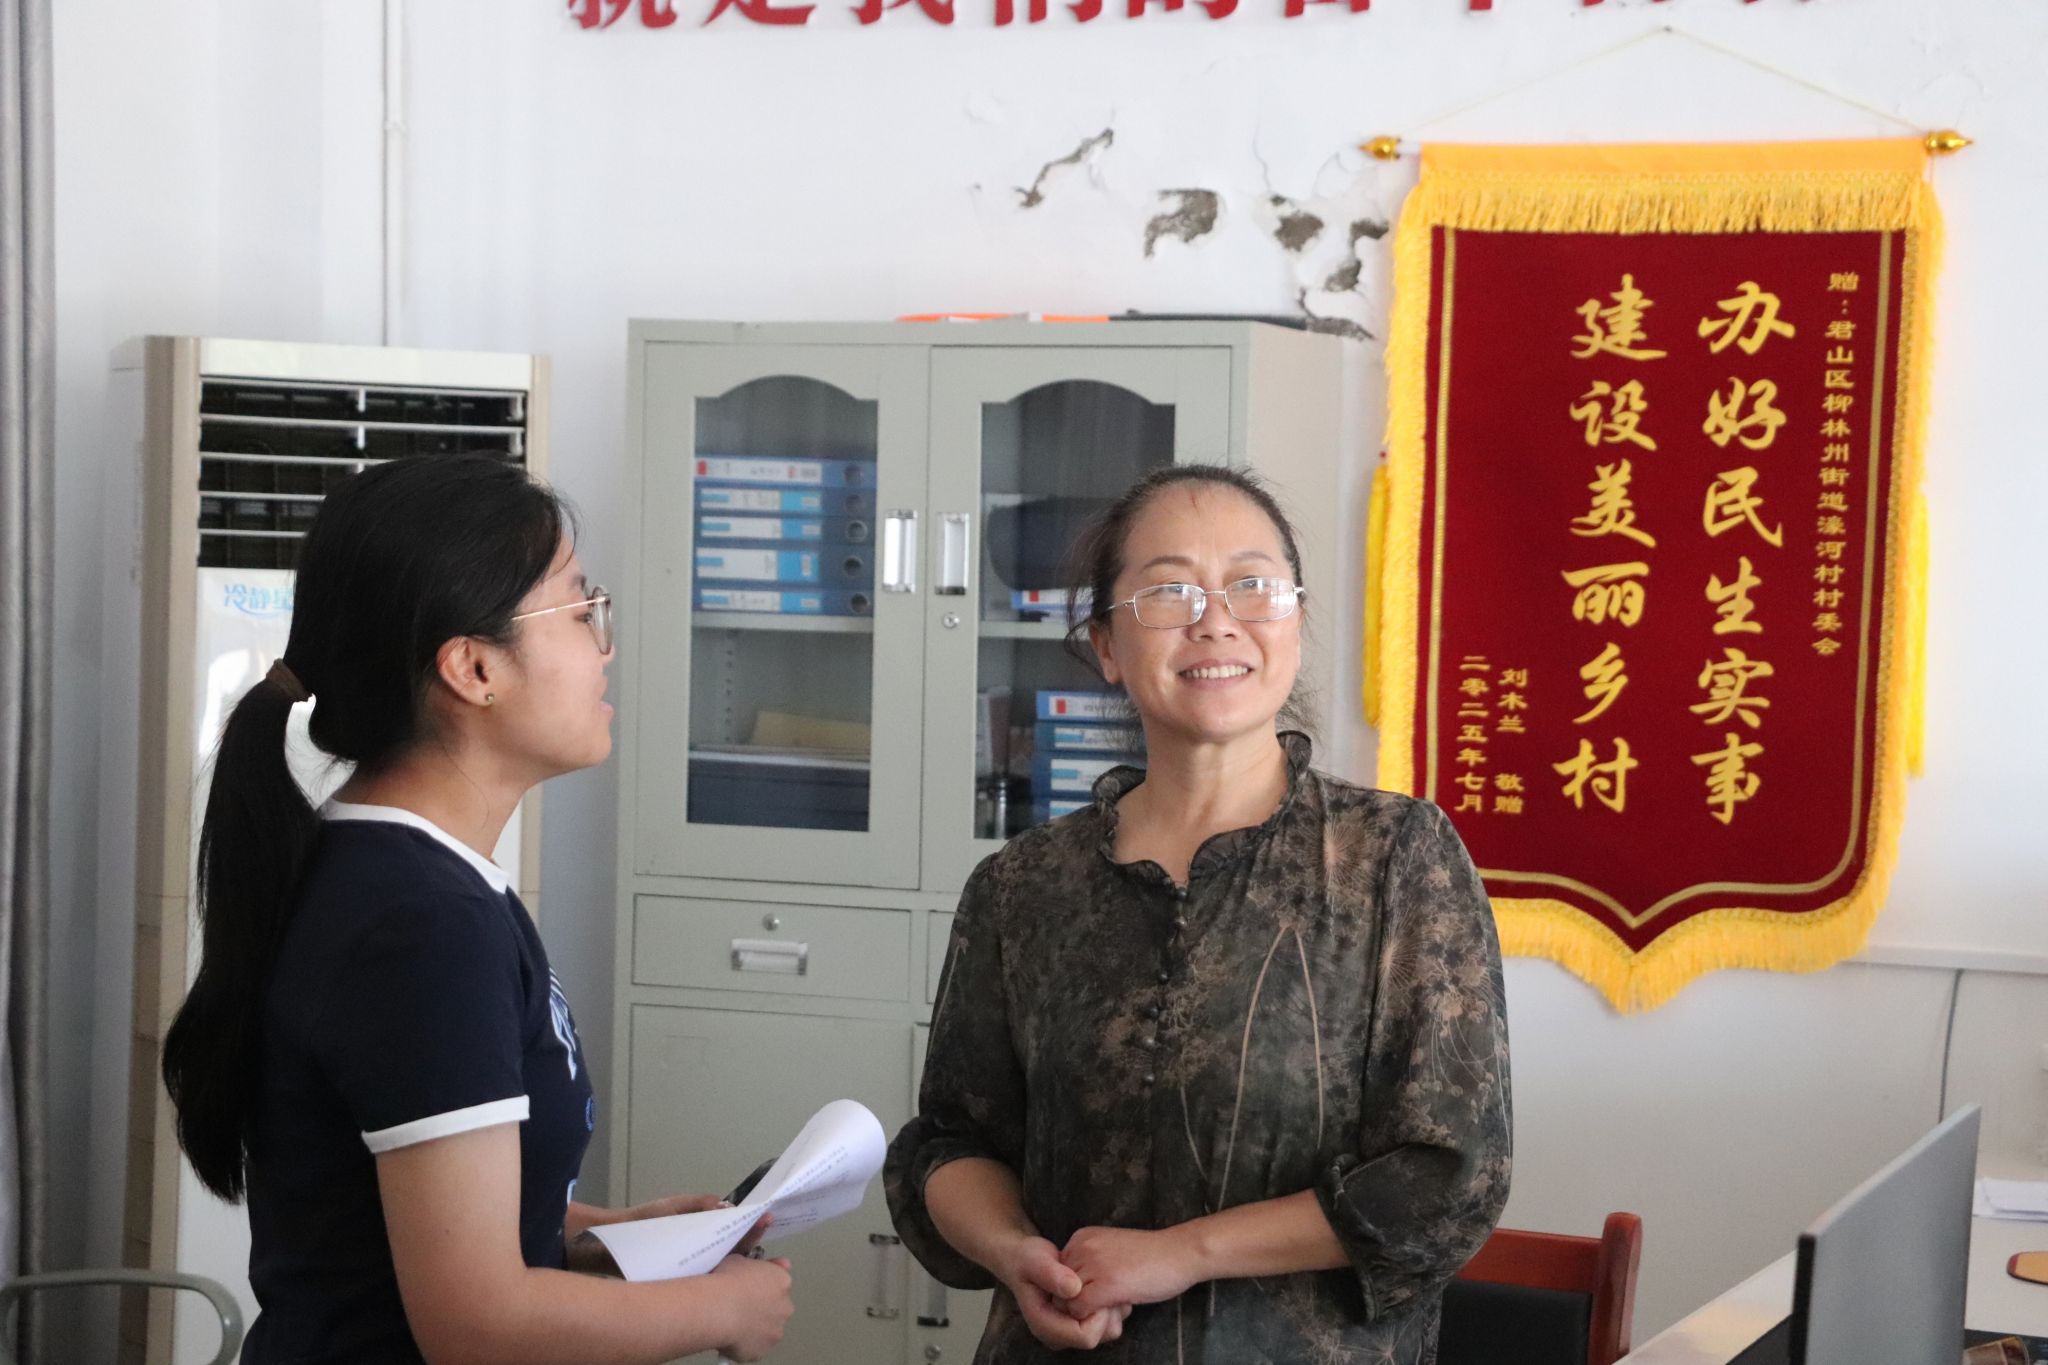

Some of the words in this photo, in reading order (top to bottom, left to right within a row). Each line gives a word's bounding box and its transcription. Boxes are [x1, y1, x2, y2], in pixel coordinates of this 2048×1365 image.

[1553, 274, 1668, 813] 建设美丽乡村
[1690, 281, 1796, 824] 办好民生实事
[1454, 655, 1491, 812] 二零二五年七月
[1496, 668, 1528, 734] 刘木兰
[1493, 773, 1525, 814] 敬赠
